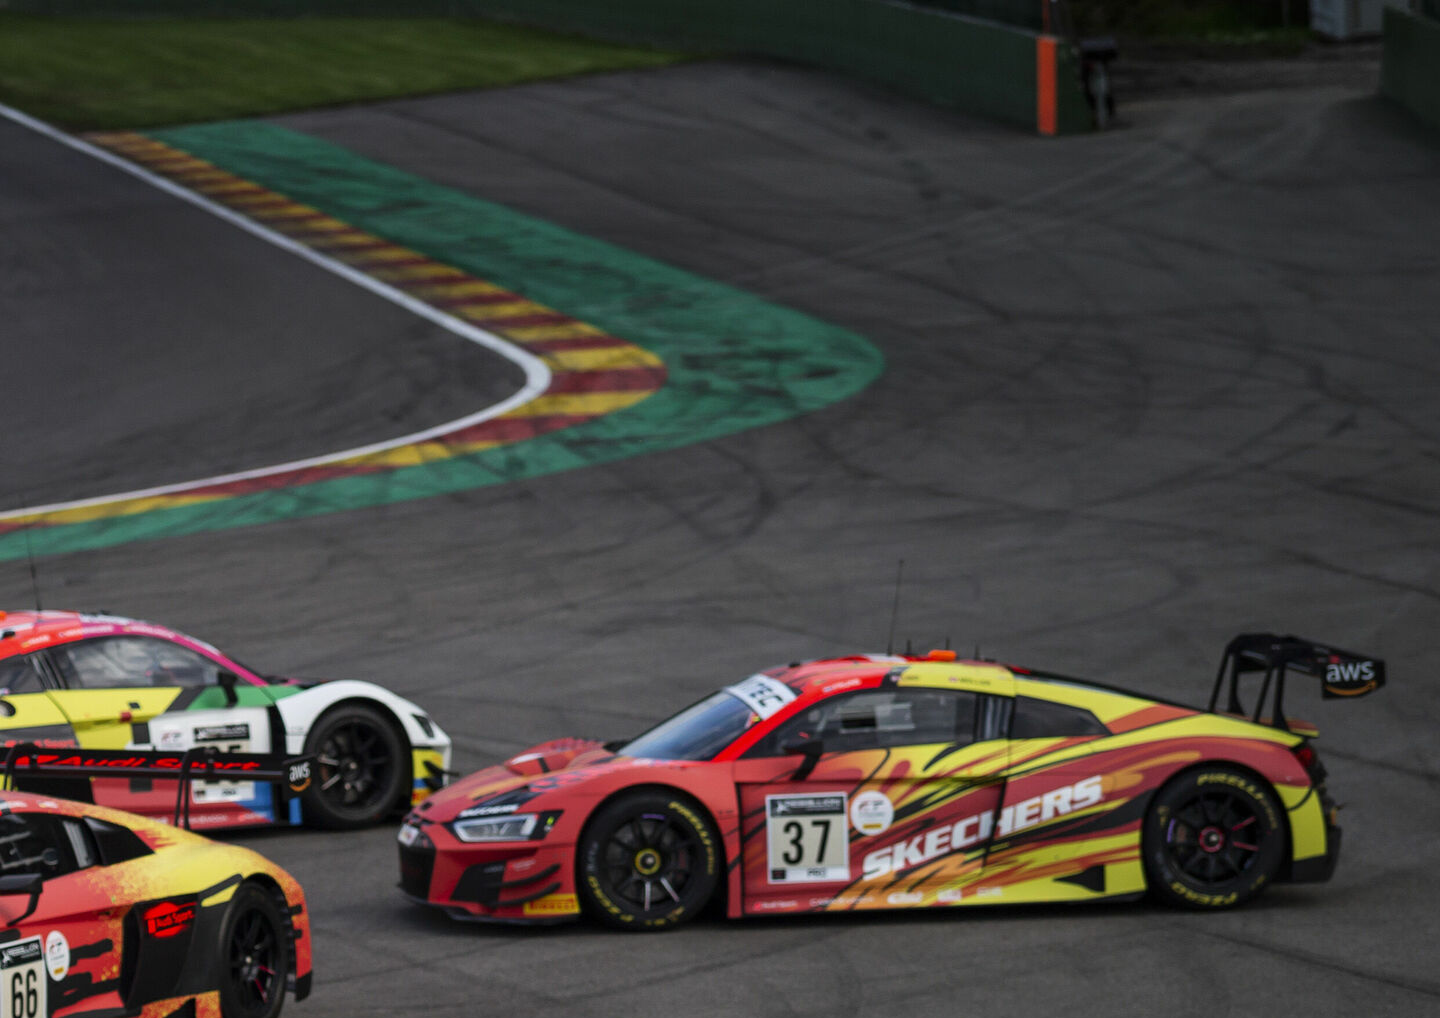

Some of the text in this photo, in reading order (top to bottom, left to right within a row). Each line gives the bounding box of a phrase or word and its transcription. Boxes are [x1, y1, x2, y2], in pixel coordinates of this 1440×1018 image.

[1326, 661, 1375, 683] aws
[53, 754, 147, 769] Audi
[289, 762, 311, 782] aws
[862, 775, 1103, 882] SKECHERS
[782, 819, 832, 867] 37
